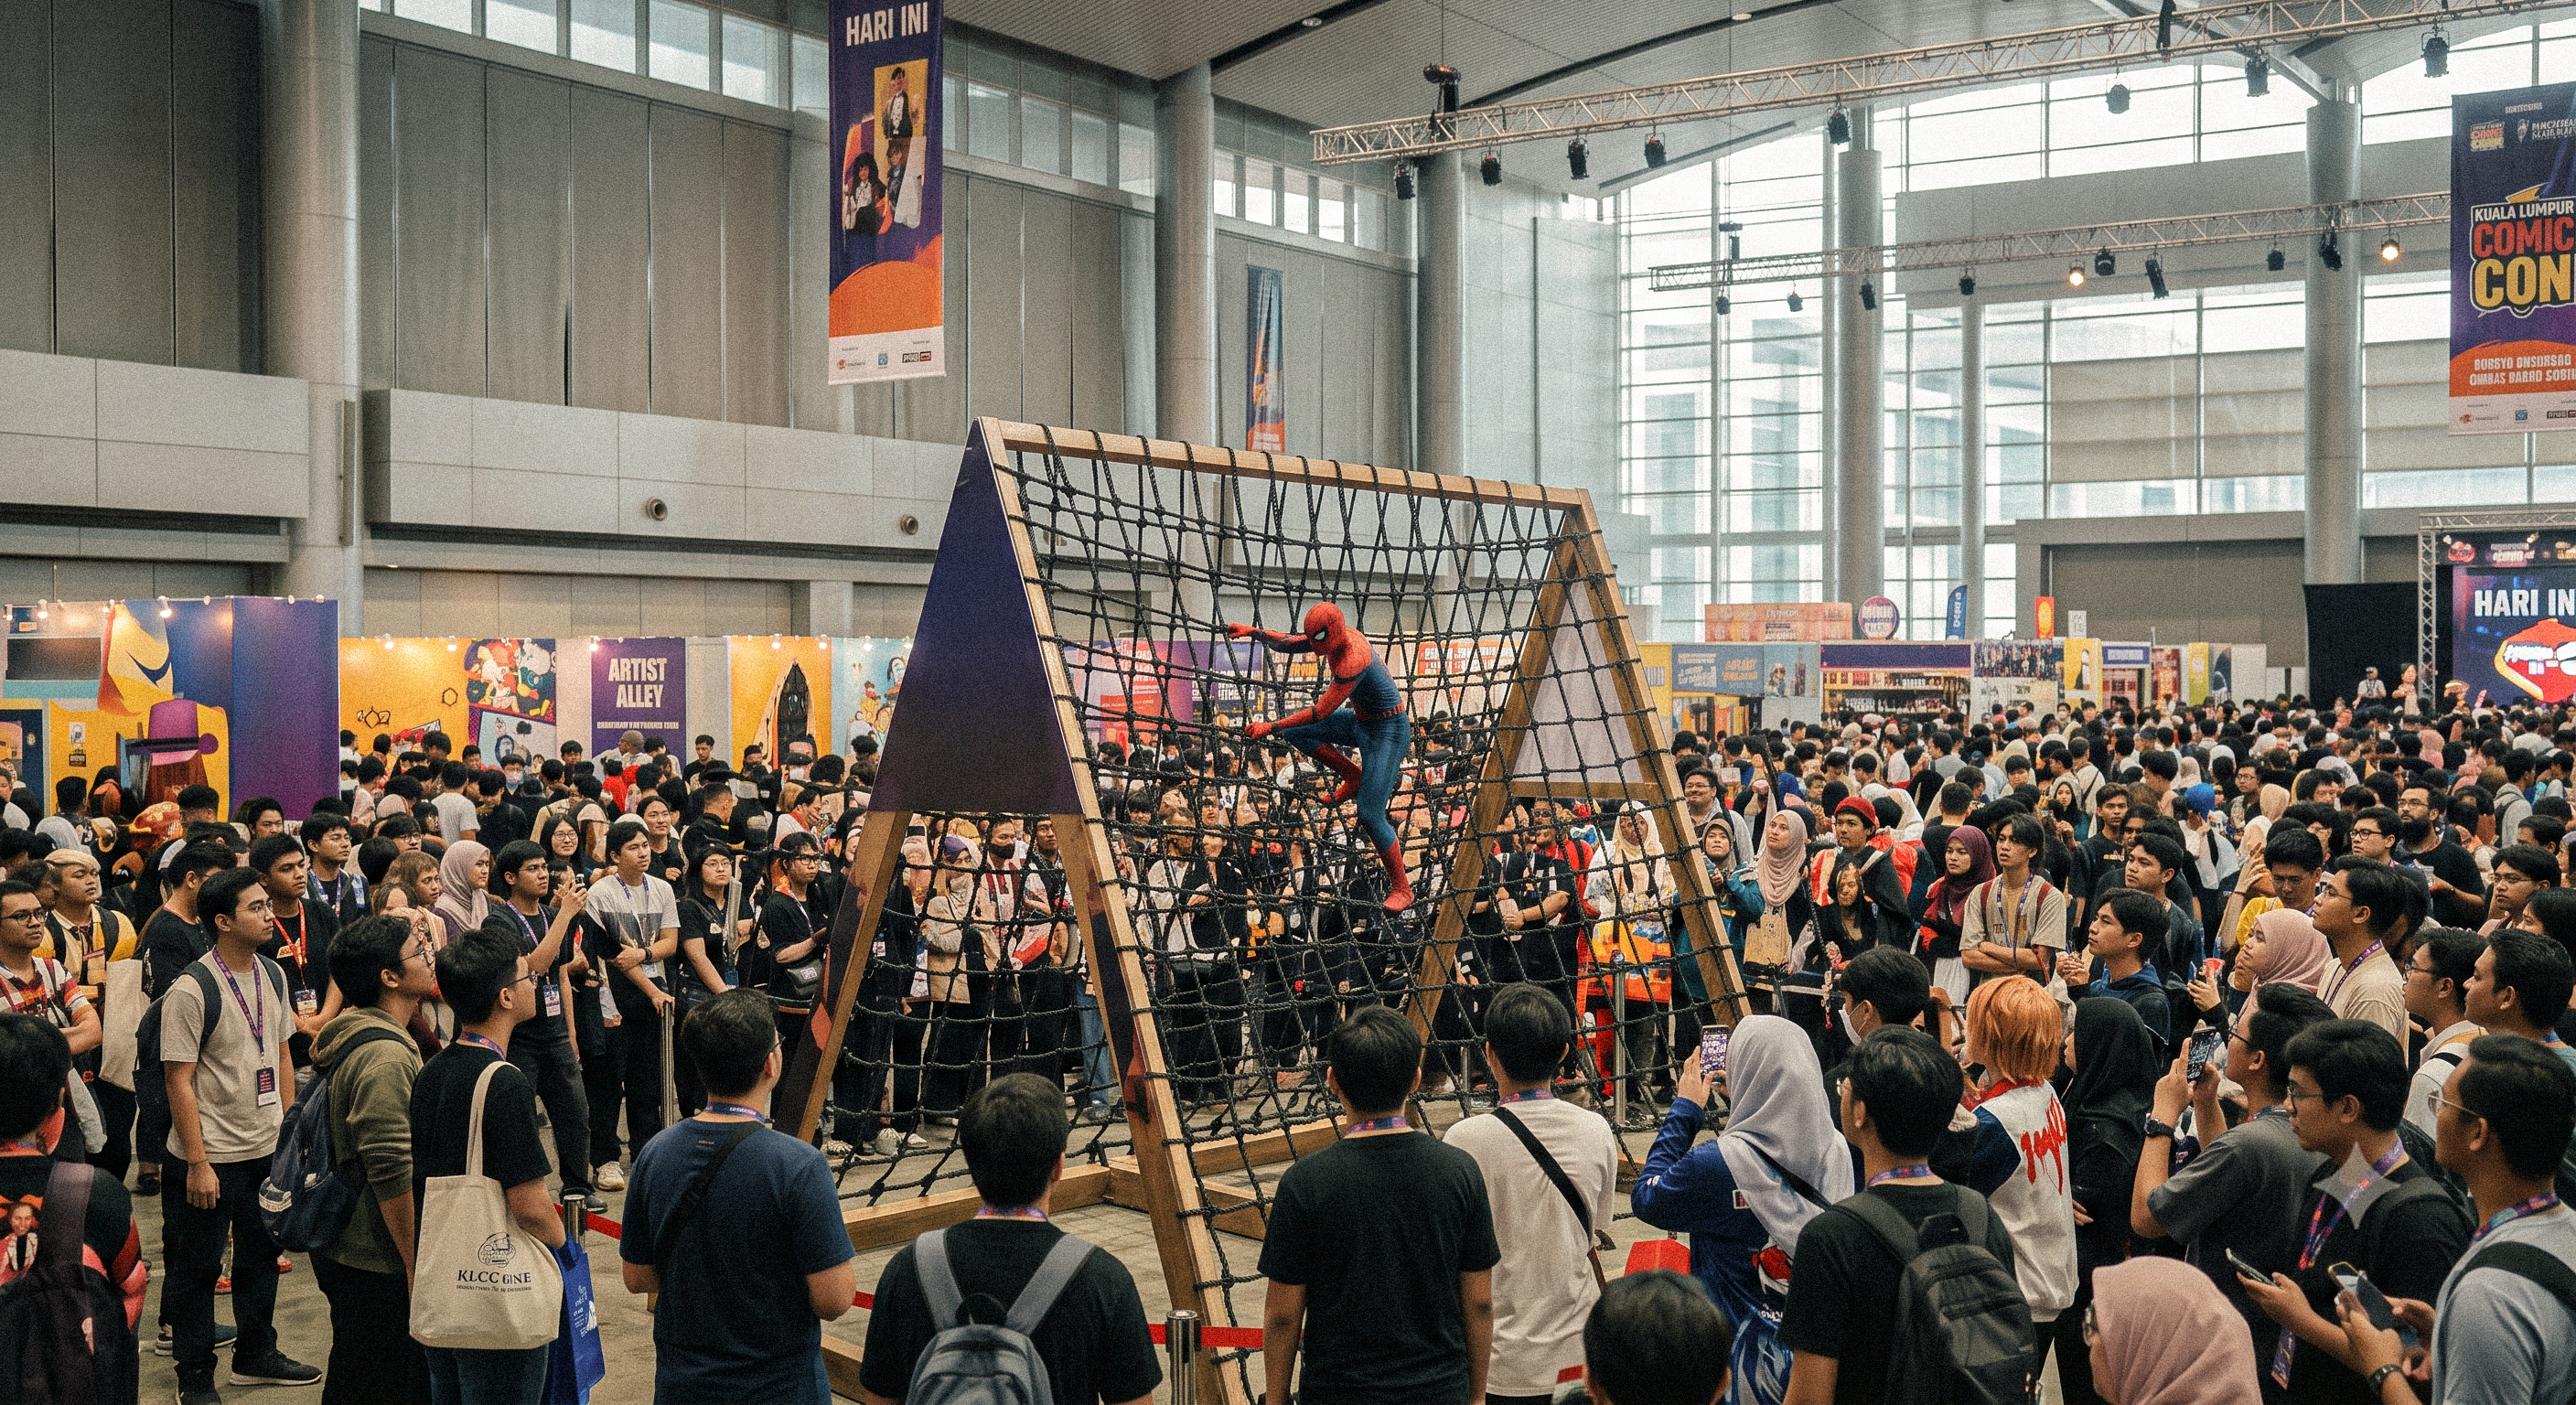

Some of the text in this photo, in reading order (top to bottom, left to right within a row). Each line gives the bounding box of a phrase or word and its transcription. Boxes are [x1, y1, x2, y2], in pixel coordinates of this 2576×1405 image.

[846, 1, 928, 47] HARI INI
[2474, 199, 2574, 222] KUALA LUMPUR
[2474, 216, 2575, 258] COMIC
[2474, 253, 2571, 307] CON
[2474, 588, 2576, 617] HARI IN
[607, 658, 668, 681] ARTIST
[616, 684, 664, 708] ALLEY
[456, 1270, 500, 1283] KLCC
